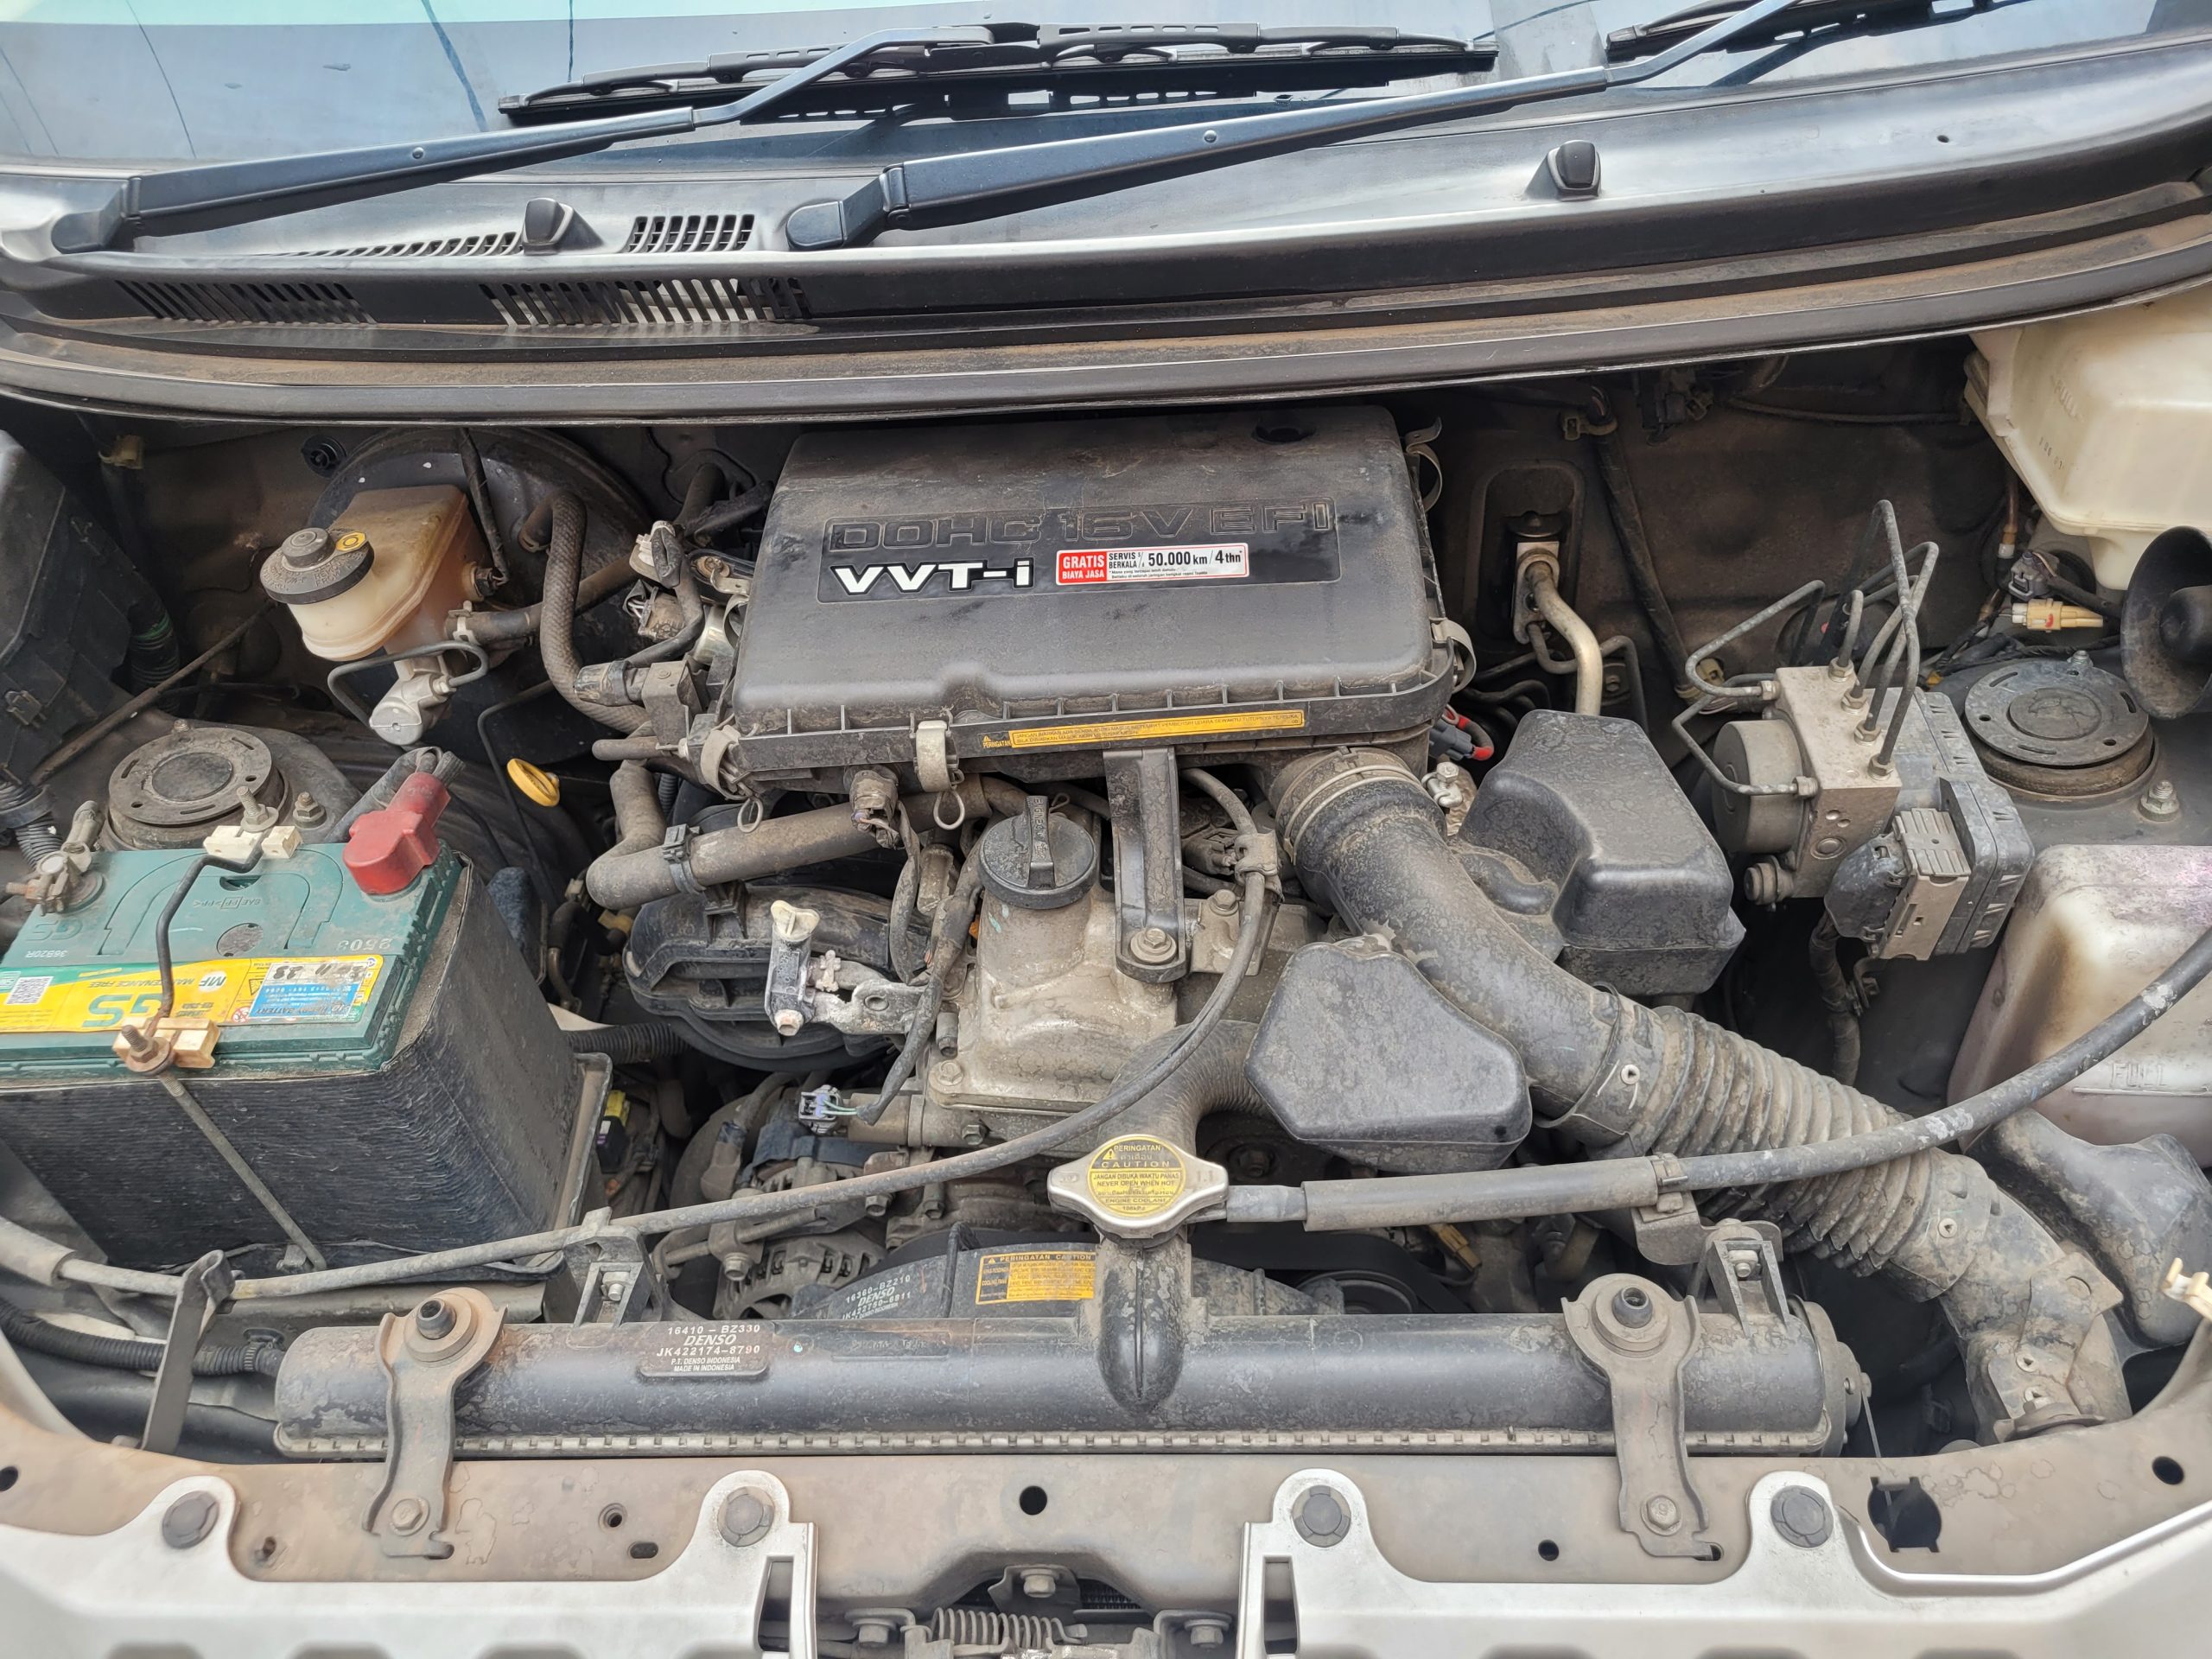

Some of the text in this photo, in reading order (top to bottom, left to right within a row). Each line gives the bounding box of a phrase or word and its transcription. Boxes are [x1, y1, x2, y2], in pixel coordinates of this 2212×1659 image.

[830, 502, 1331, 552] DOHC 16V EFI
[1063, 555, 1105, 569] GRATIS
[1109, 551, 1136, 561] SERVIS
[1148, 551, 1192, 567] 50.000
[1192, 555, 1208, 565] km
[1215, 550, 1224, 564] 4
[1109, 560, 1137, 569] BERKALA
[833, 559, 1032, 594] VVT-i
[1062, 569, 1104, 580] BIAYA JASA
[982, 740, 1011, 749] PERINGATAN
[26, 918, 83, 941] GS
[200, 976, 227, 988] MF
[1000, 1254, 1051, 1262] PERINGATAN
[845, 1274, 911, 1304] 16360-BZ210
[858, 1287, 895, 1307] DENSO
[668, 1325, 704, 1335] 16410
[721, 1324, 760, 1333] BZ330
[683, 1334, 737, 1346] DENSO
[657, 1345, 760, 1357] JK422174-8790
[706, 1356, 741, 1364] INDONESIA
